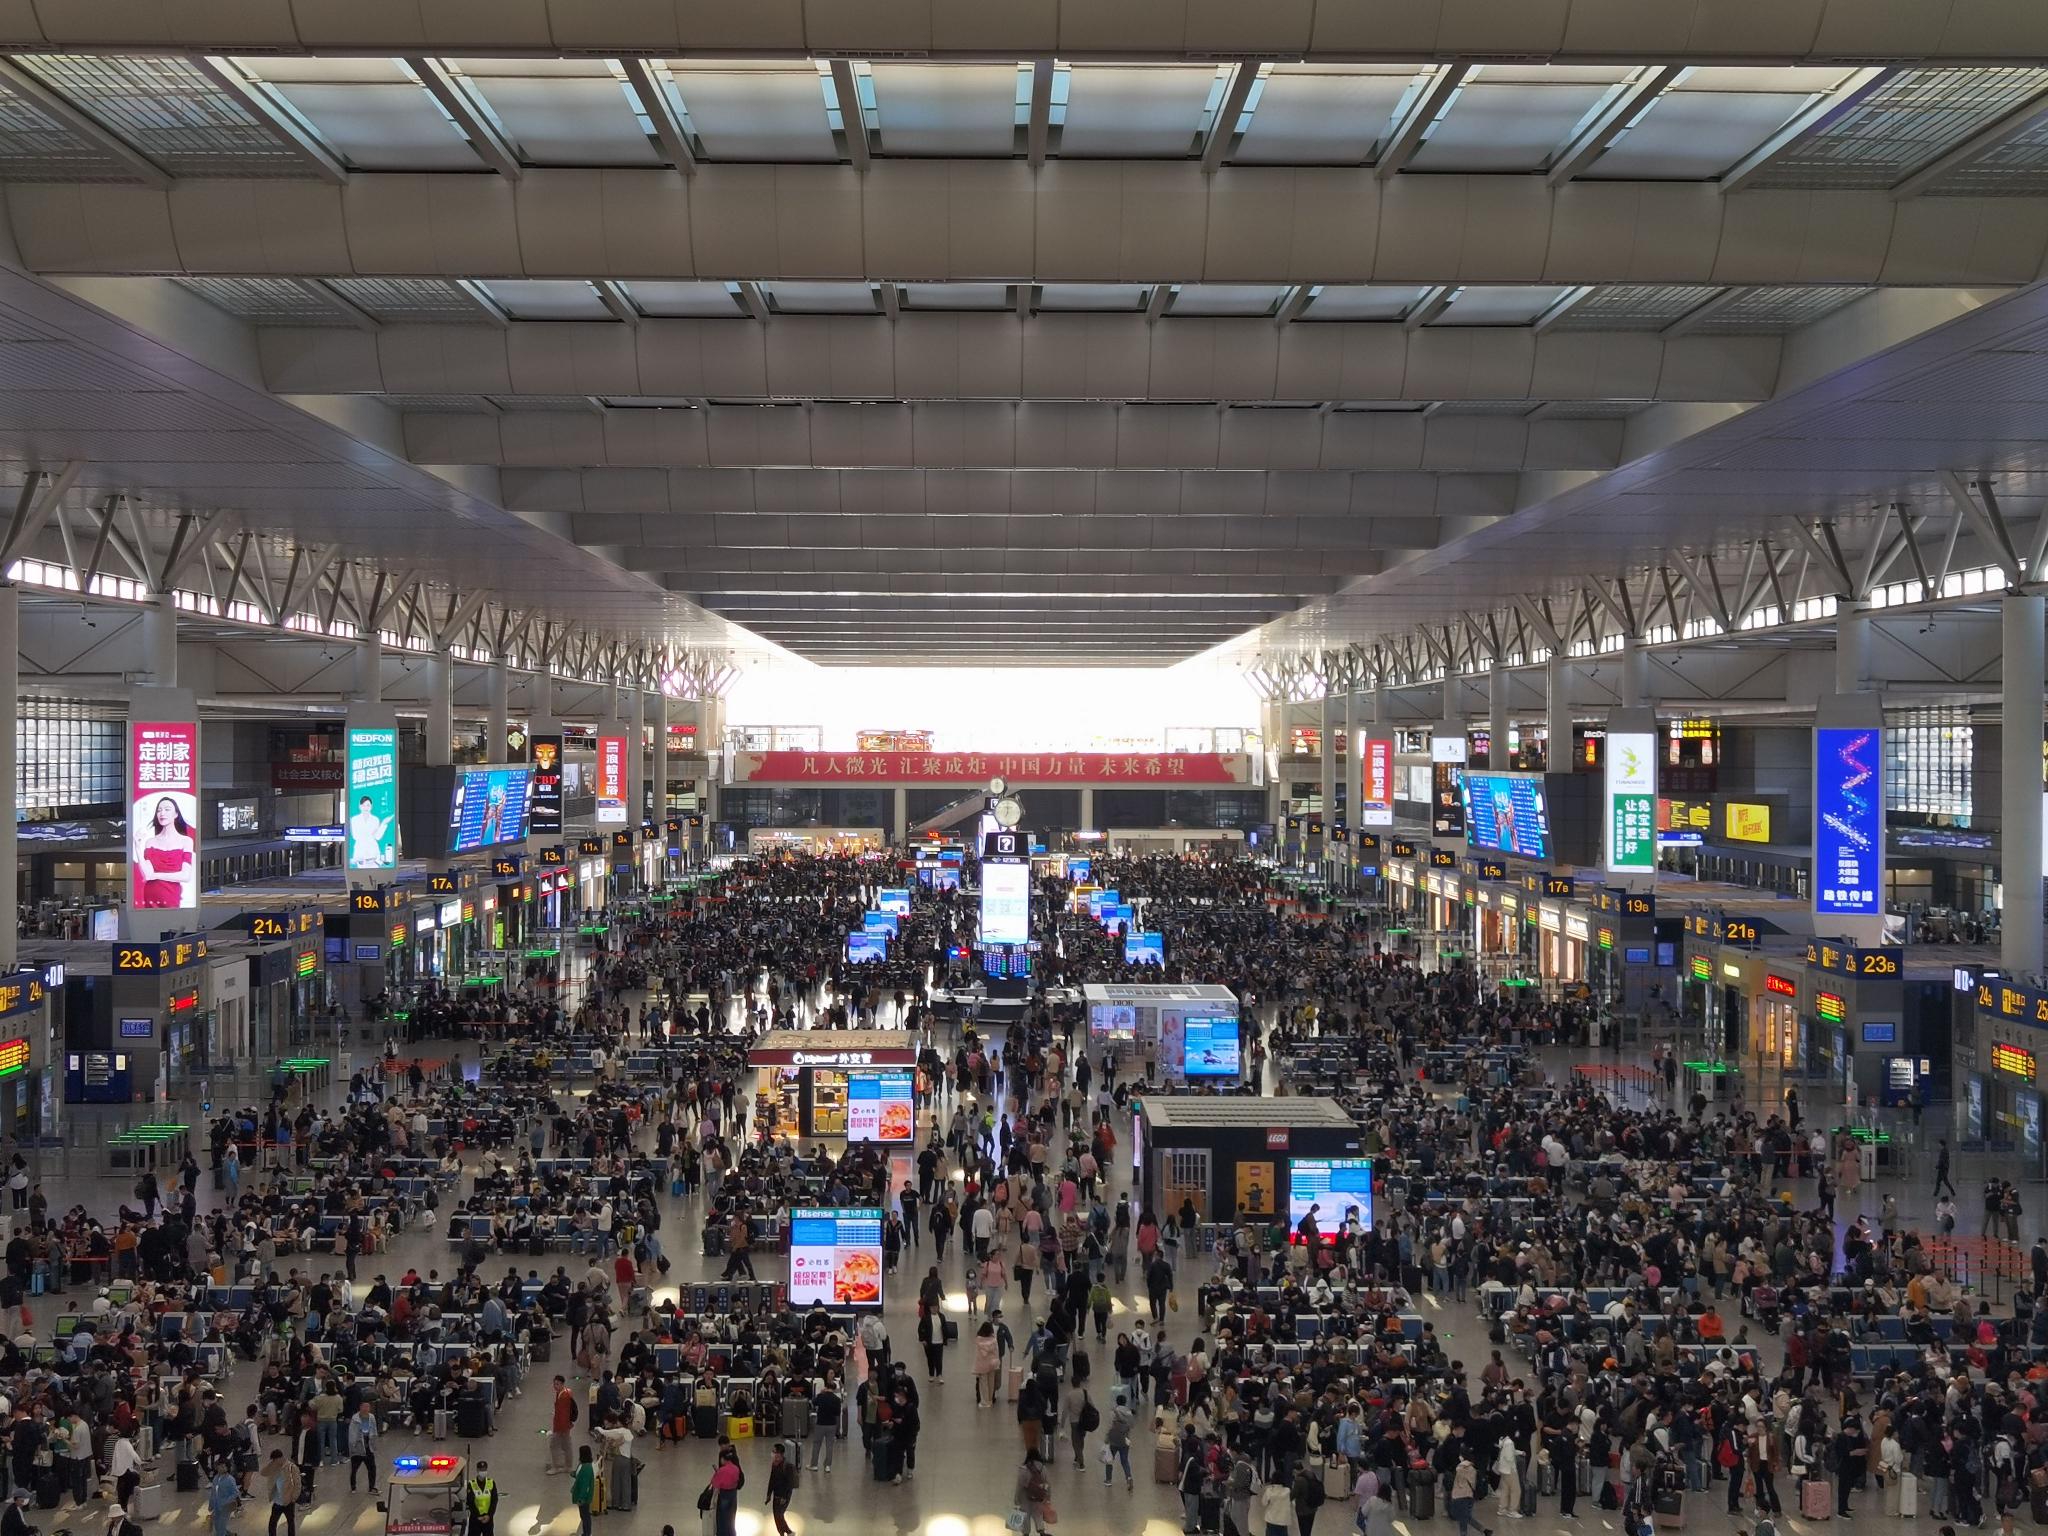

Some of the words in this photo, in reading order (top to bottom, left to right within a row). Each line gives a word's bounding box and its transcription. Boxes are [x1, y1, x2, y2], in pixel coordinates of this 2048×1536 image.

[352, 734, 393, 743] NEDFON
[139, 742, 191, 761] 定制家
[139, 762, 191, 781] 索菲亚
[802, 757, 889, 776] 凡人微光
[901, 757, 988, 776] 汇聚成炬
[999, 757, 1086, 776] 中国力量
[1098, 757, 1185, 776] 未来希望
[534, 776, 557, 785] CBD
[583, 841, 599, 852] 11A
[1395, 845, 1410, 855] 11B
[544, 851, 561, 861] 13A
[1434, 855, 1451, 864] 13B
[496, 862, 515, 873] 15A
[1483, 866, 1501, 877] 15B
[431, 878, 453, 890] 17A
[1548, 881, 1569, 893] 17B
[355, 895, 379, 909] 19A
[1626, 899, 1649, 913] 19B
[254, 919, 283, 934] 21A
[1727, 923, 1755, 939] 21B
[120, 950, 153, 968] 23A
[1863, 955, 1897, 973] 23B
[1979, 985, 1993, 1007] 24B
[1268, 1134, 1288, 1144] LEGO
[1294, 1160, 1330, 1169] Hisense
[796, 1208, 835, 1218] Hisense
